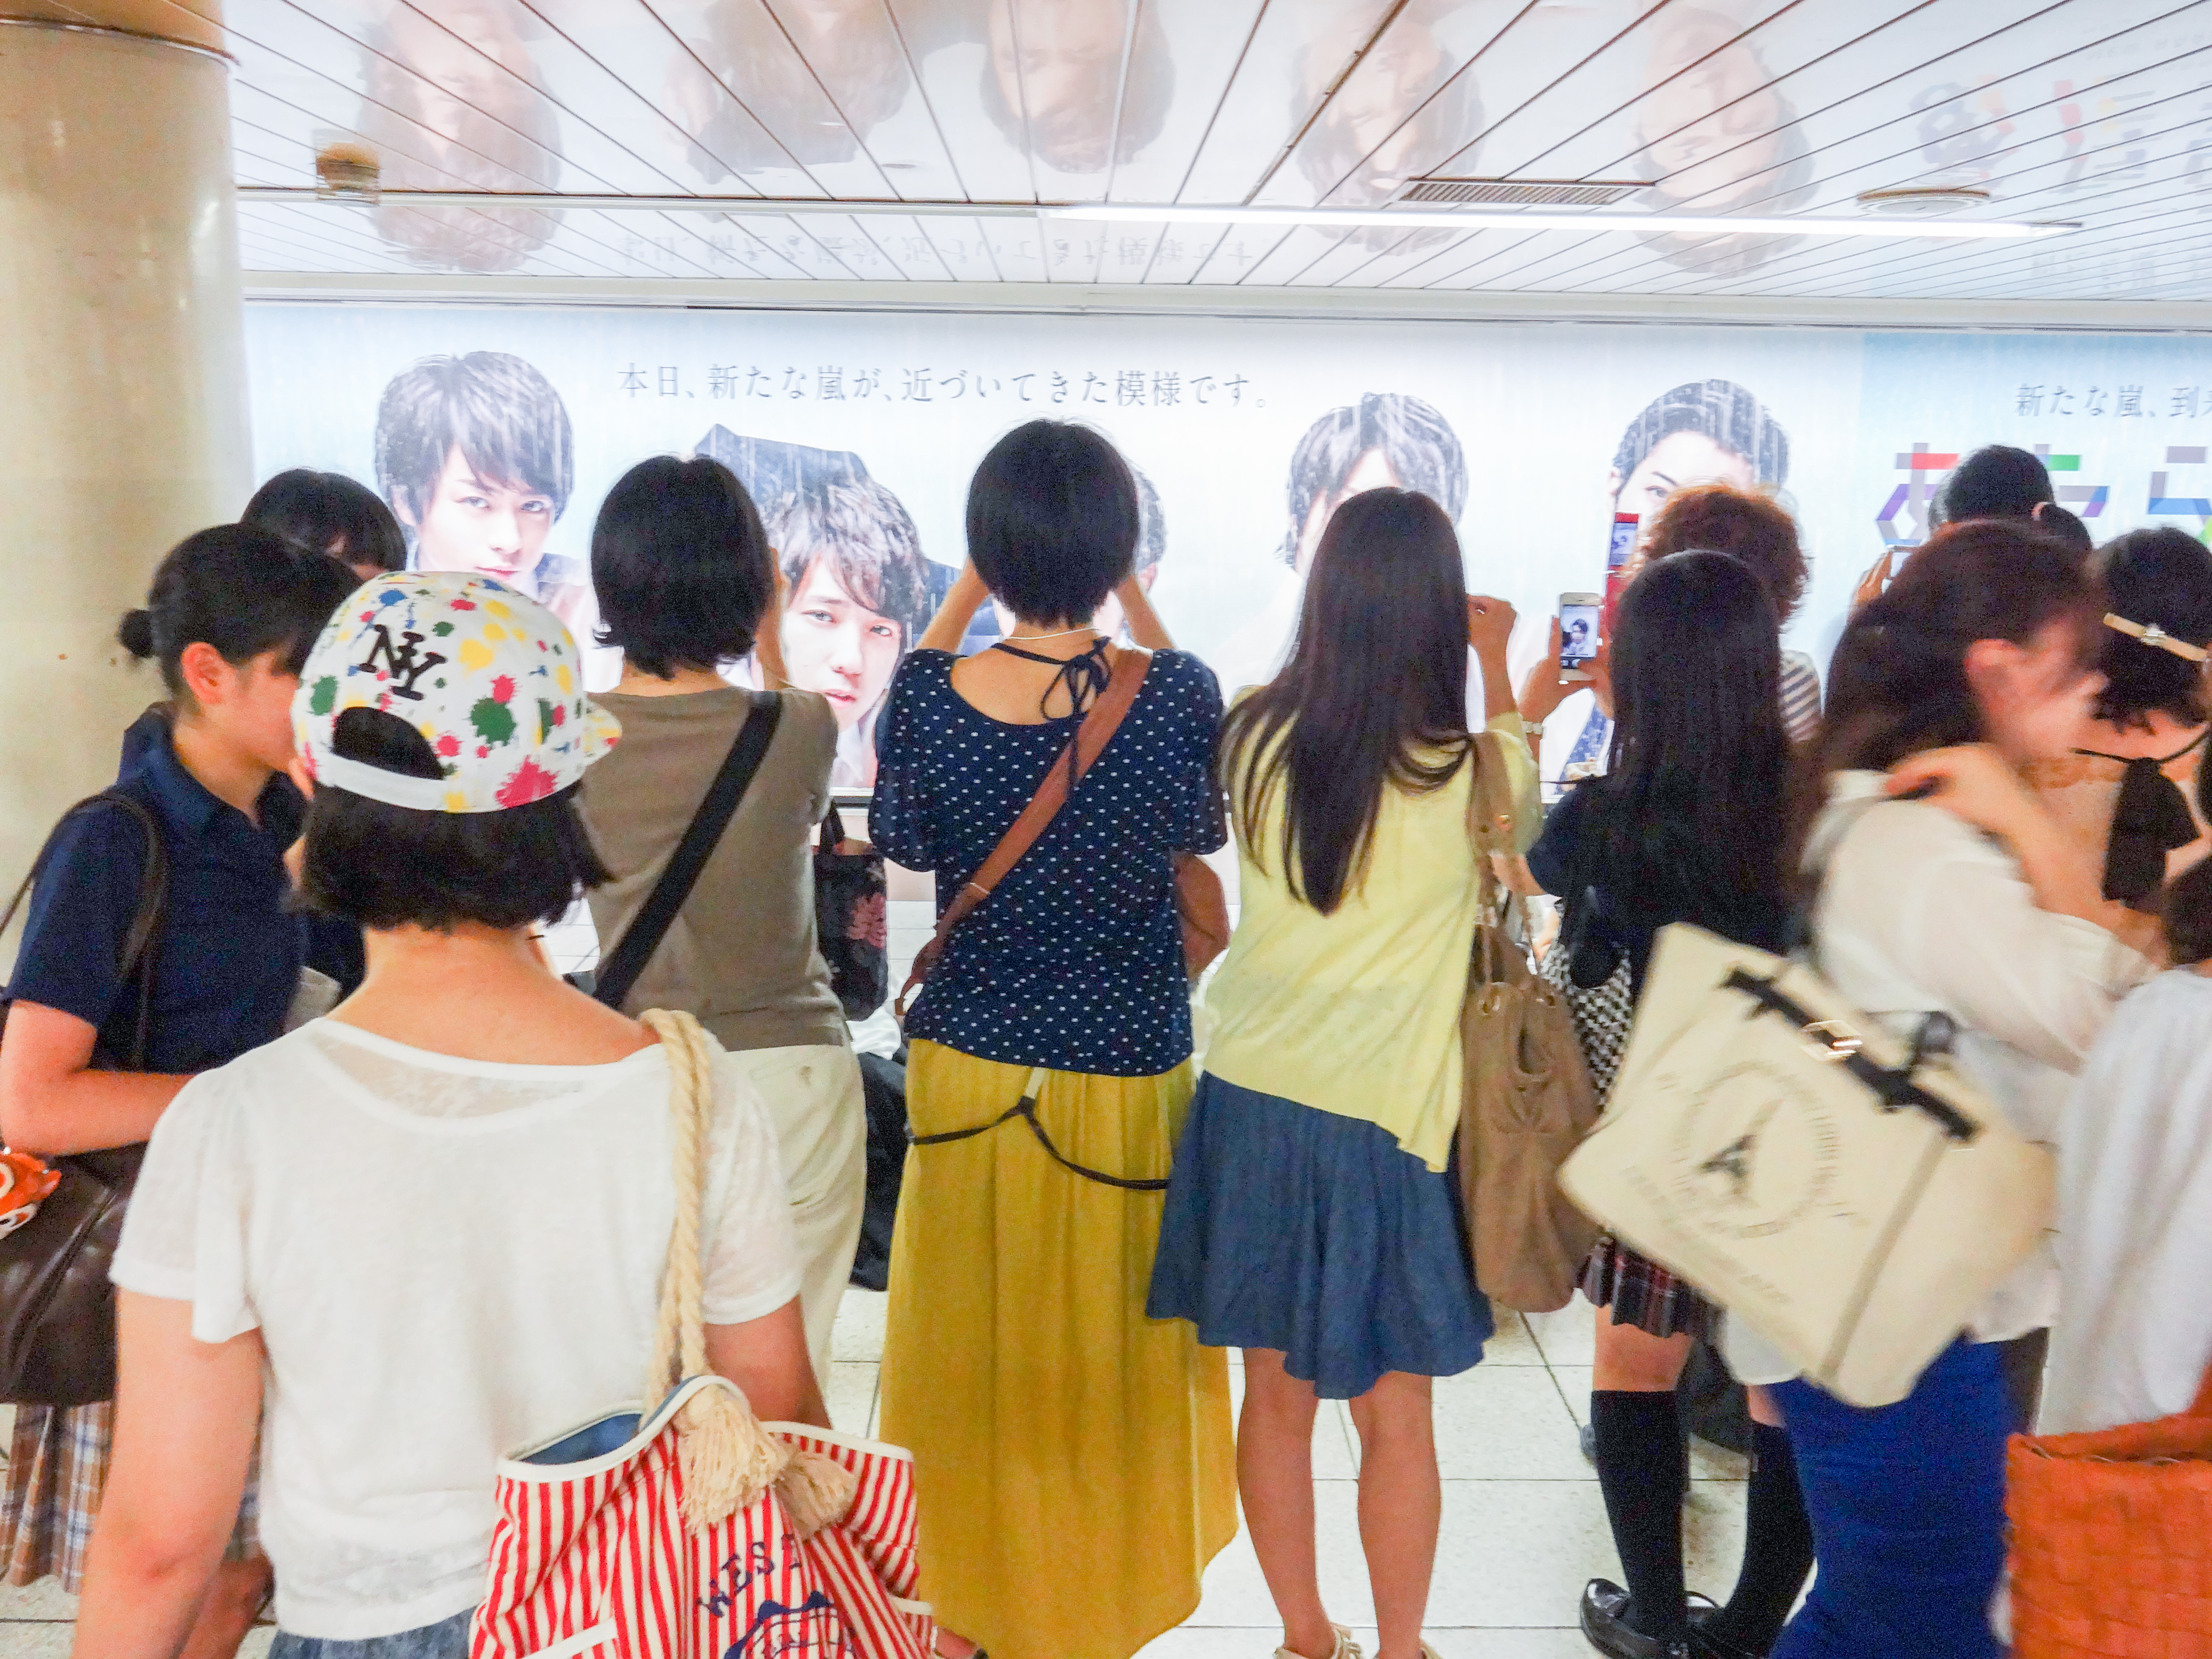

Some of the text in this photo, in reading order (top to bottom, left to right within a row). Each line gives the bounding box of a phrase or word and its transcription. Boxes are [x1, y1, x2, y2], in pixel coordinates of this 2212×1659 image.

[2014, 383, 2212, 419] 新たな嵐、到
[358, 623, 448, 701] NY
